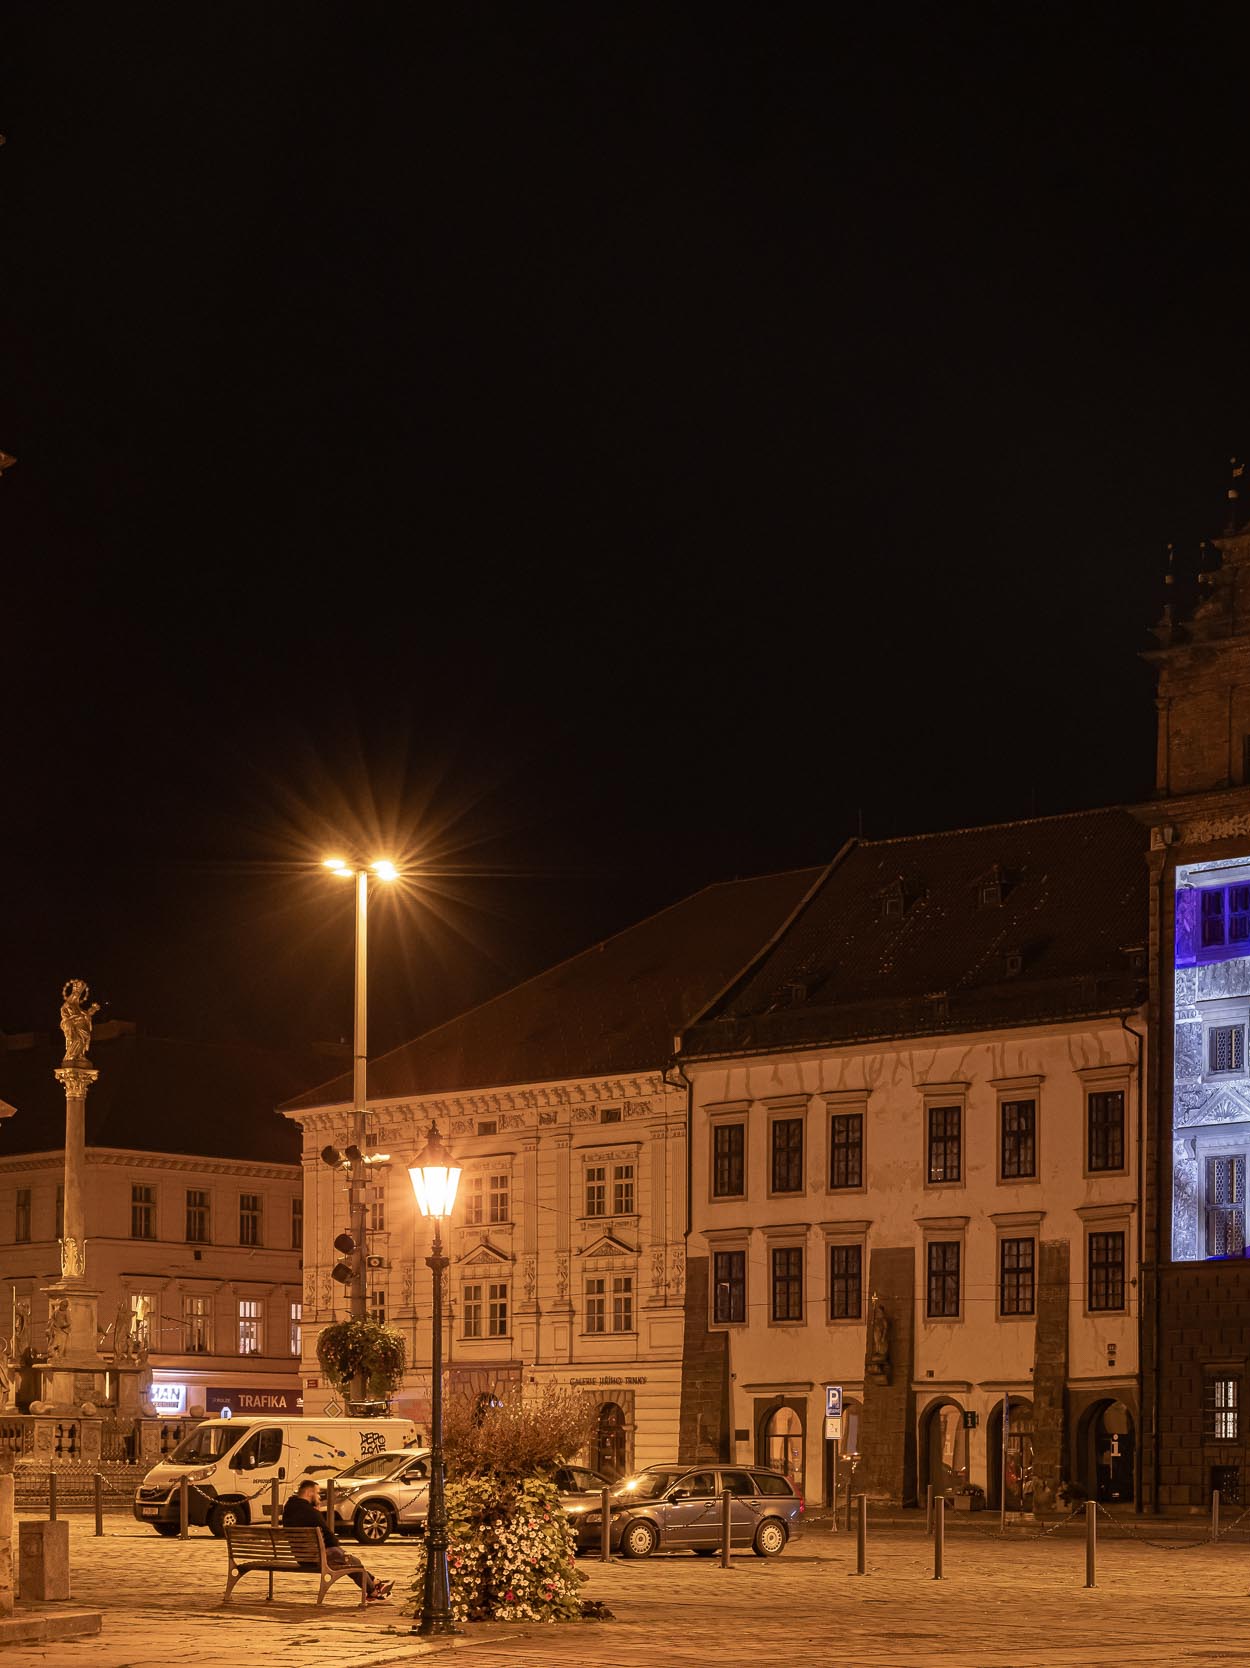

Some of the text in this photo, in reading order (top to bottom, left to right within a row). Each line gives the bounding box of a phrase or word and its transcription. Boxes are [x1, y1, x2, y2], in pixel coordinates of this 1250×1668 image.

[570, 1377, 597, 1385] GALERIE
[624, 1376, 647, 1385] TRNKY
[238, 1394, 287, 1408] TRAFIKA
[829, 1390, 839, 1408] P
[359, 1432, 386, 1446] DEPO
[361, 1445, 387, 1455] 2015
